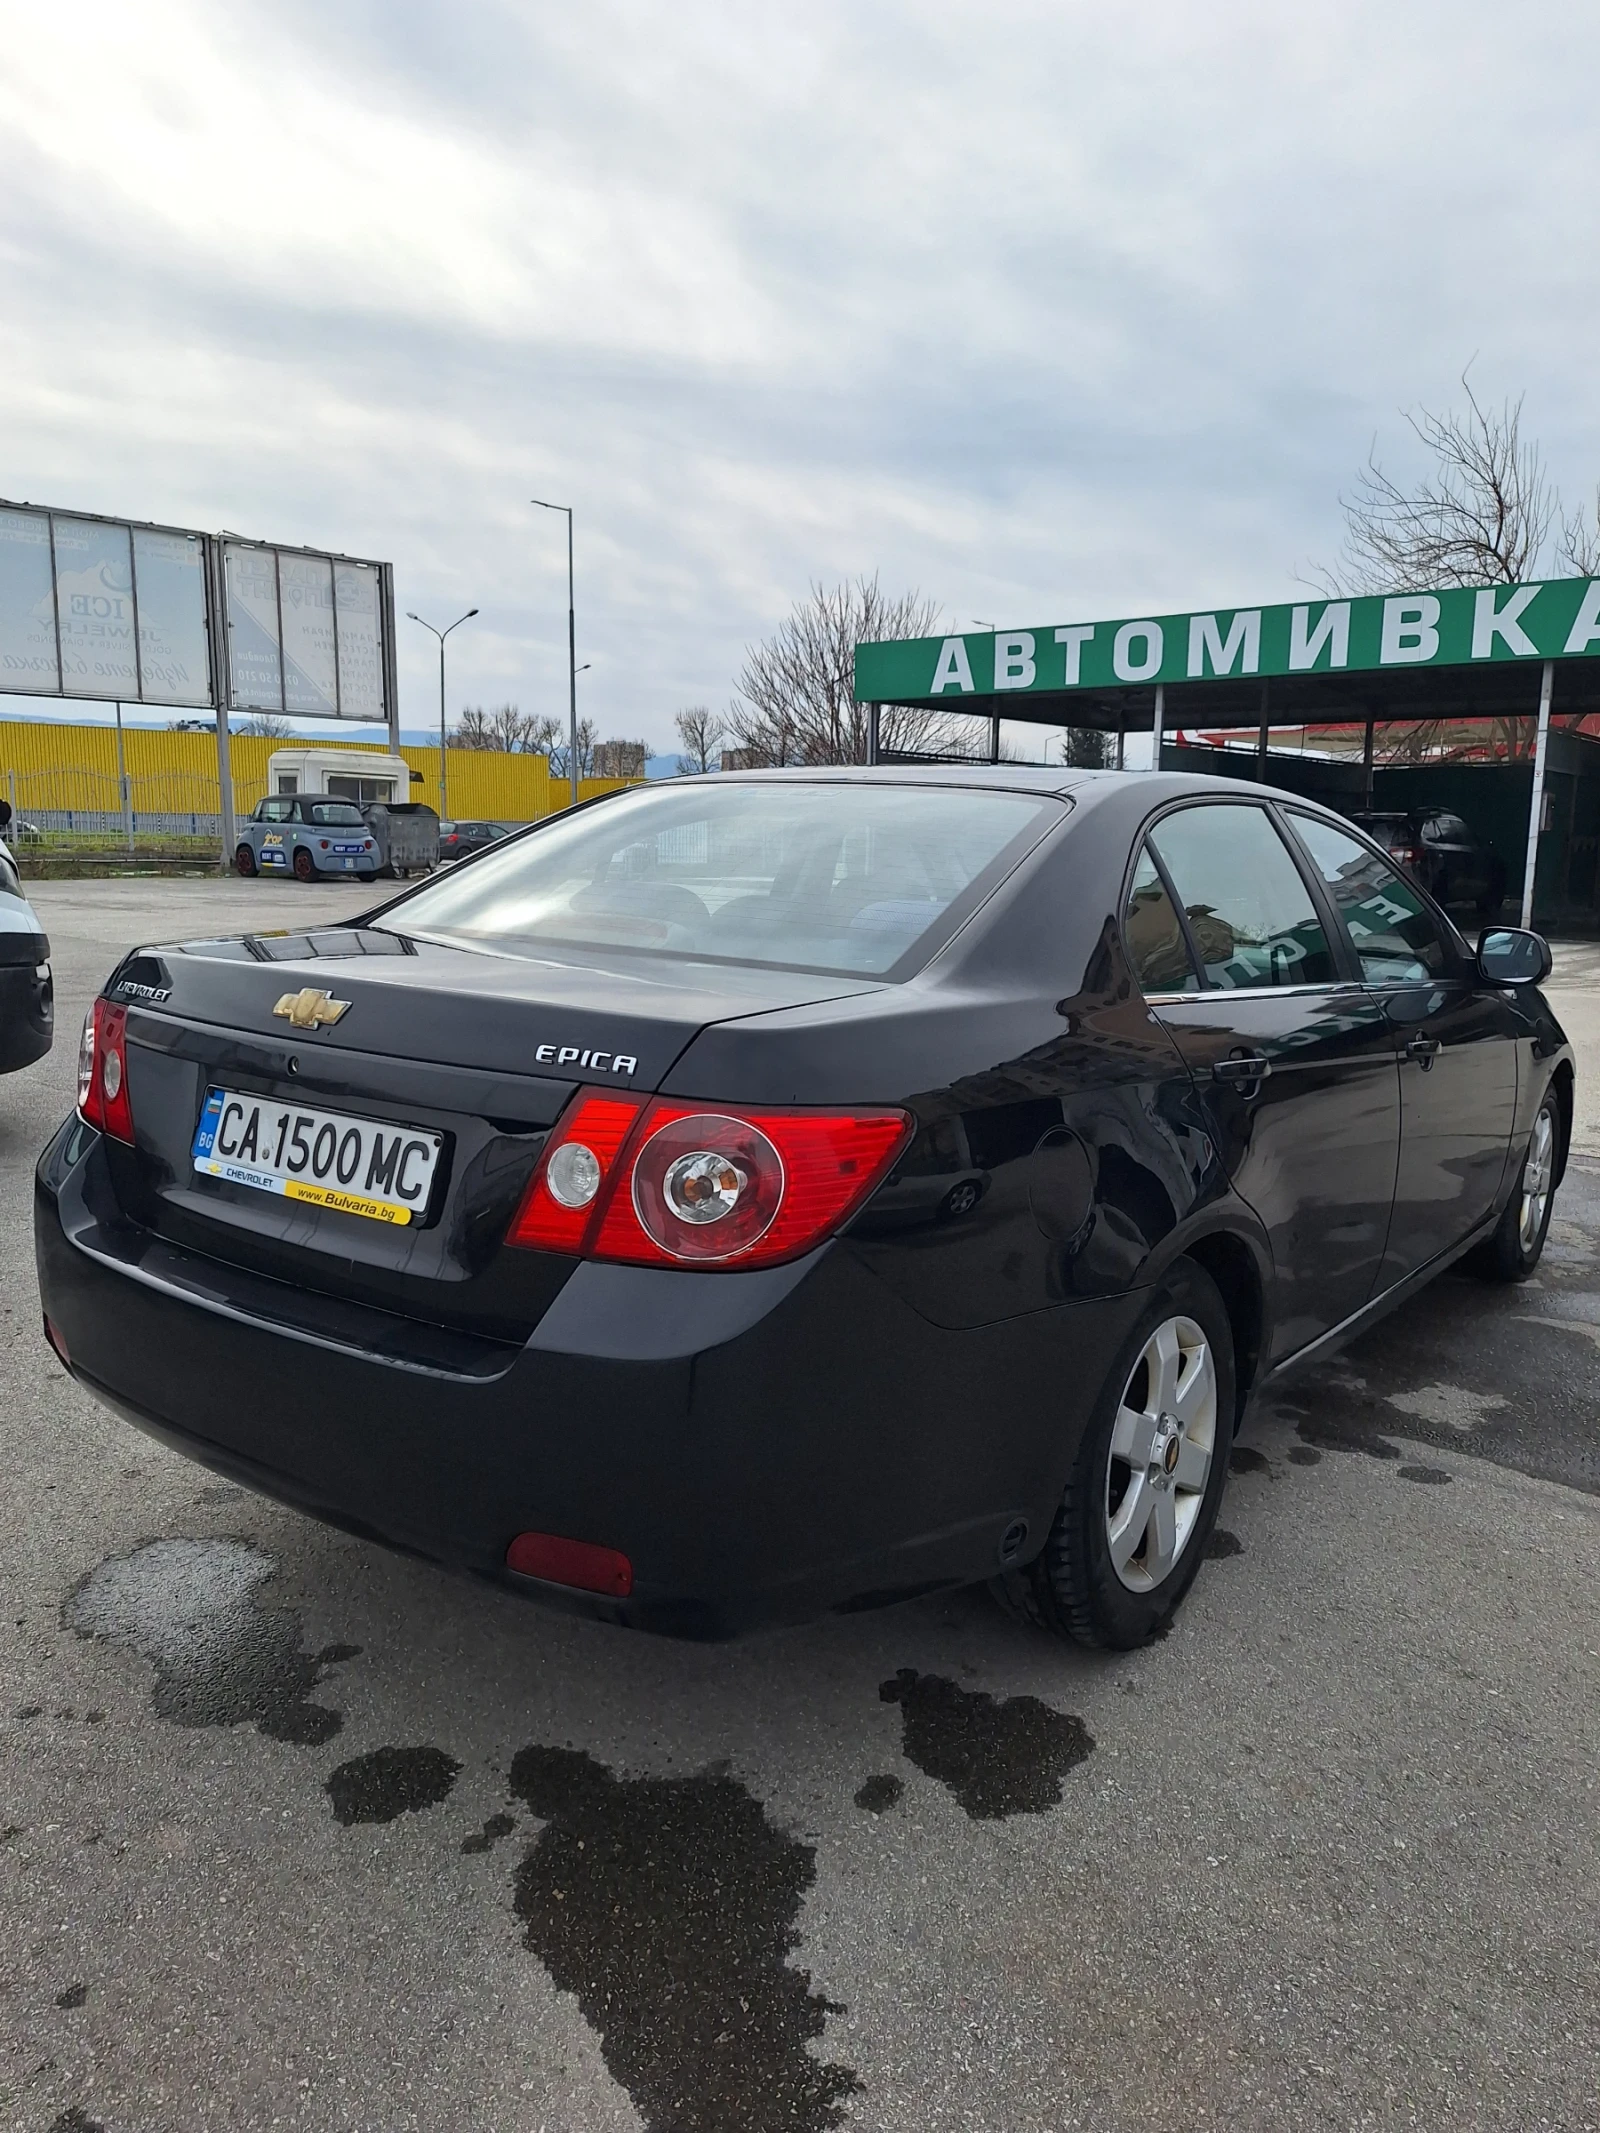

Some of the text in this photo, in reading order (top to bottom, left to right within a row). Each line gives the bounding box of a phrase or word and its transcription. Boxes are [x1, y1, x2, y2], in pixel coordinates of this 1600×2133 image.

[535, 1044, 637, 1075] EPICA
[198, 1131, 213, 1149] BG
[274, 1114, 362, 1185] 1500
[226, 1168, 274, 1188] CHEVROLET
[297, 1187, 395, 1221] www.Bulvaria.bg
